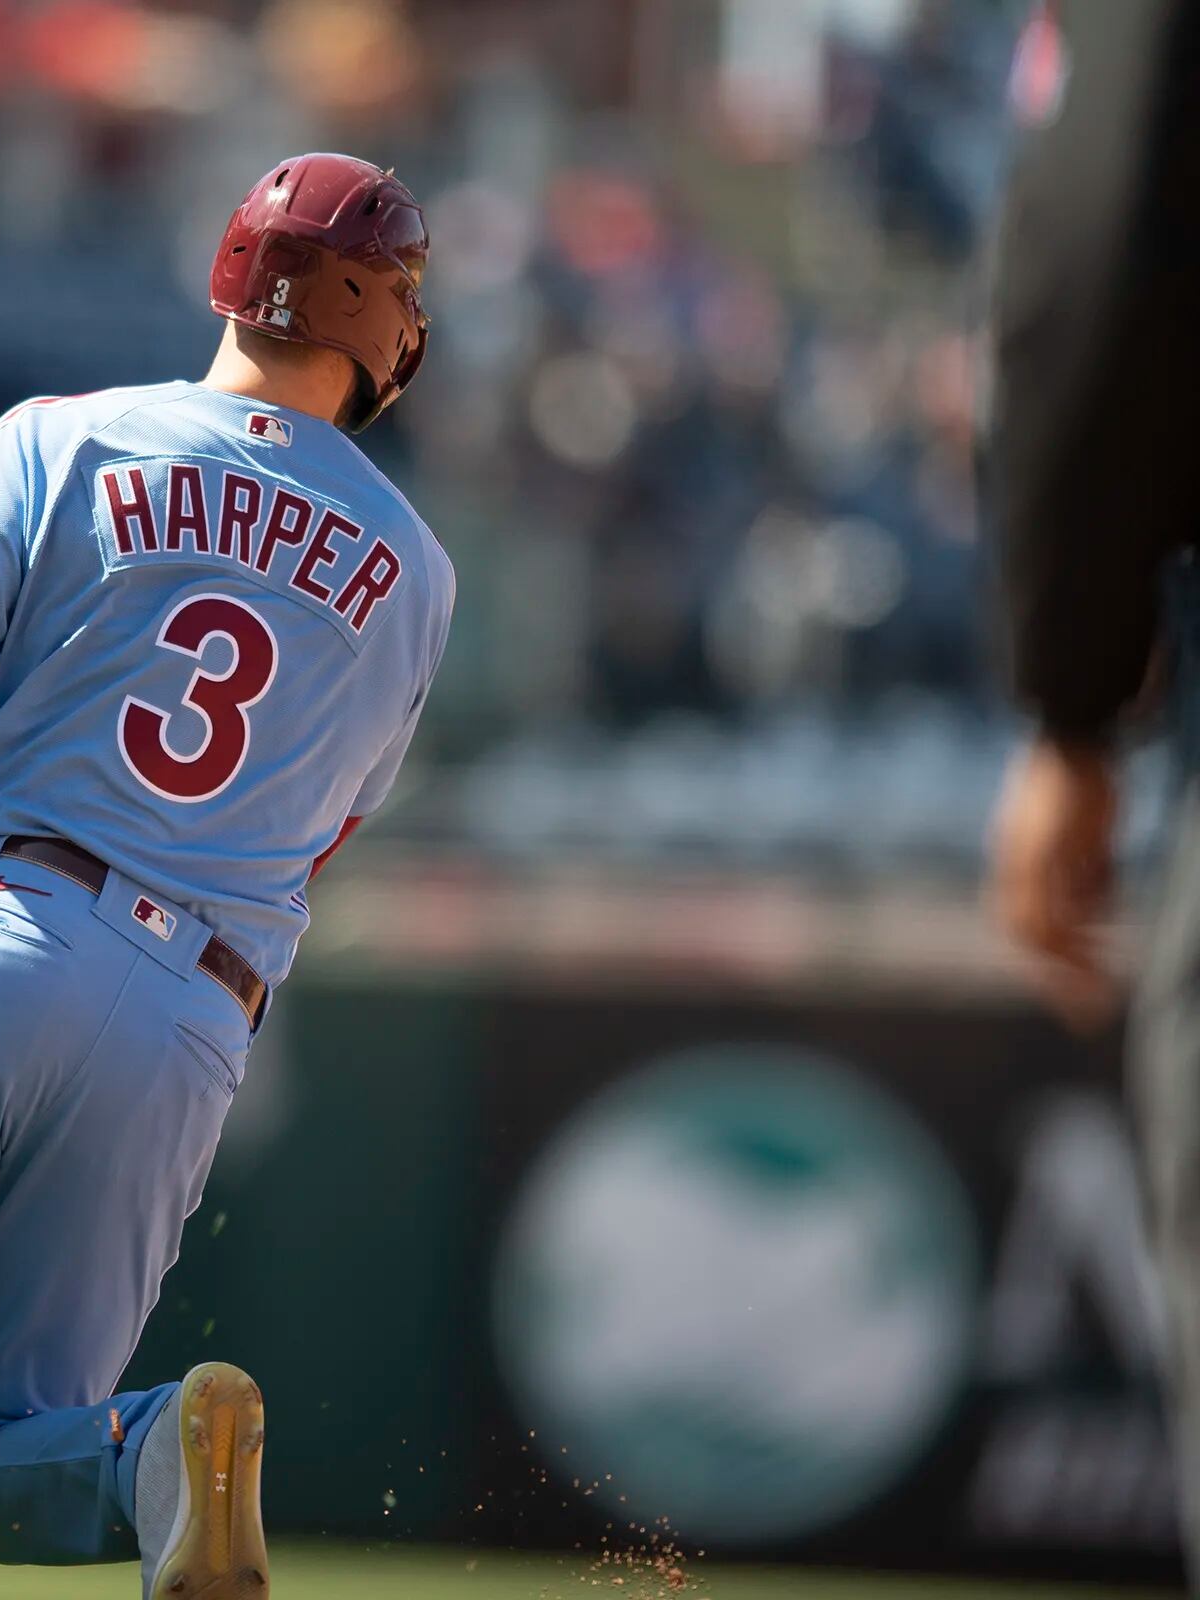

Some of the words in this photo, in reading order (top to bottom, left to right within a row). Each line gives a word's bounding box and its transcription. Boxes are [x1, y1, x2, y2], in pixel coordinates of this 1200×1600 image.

[273, 279, 290, 305] 3
[99, 463, 402, 636] HARPER
[117, 593, 279, 803] 3
